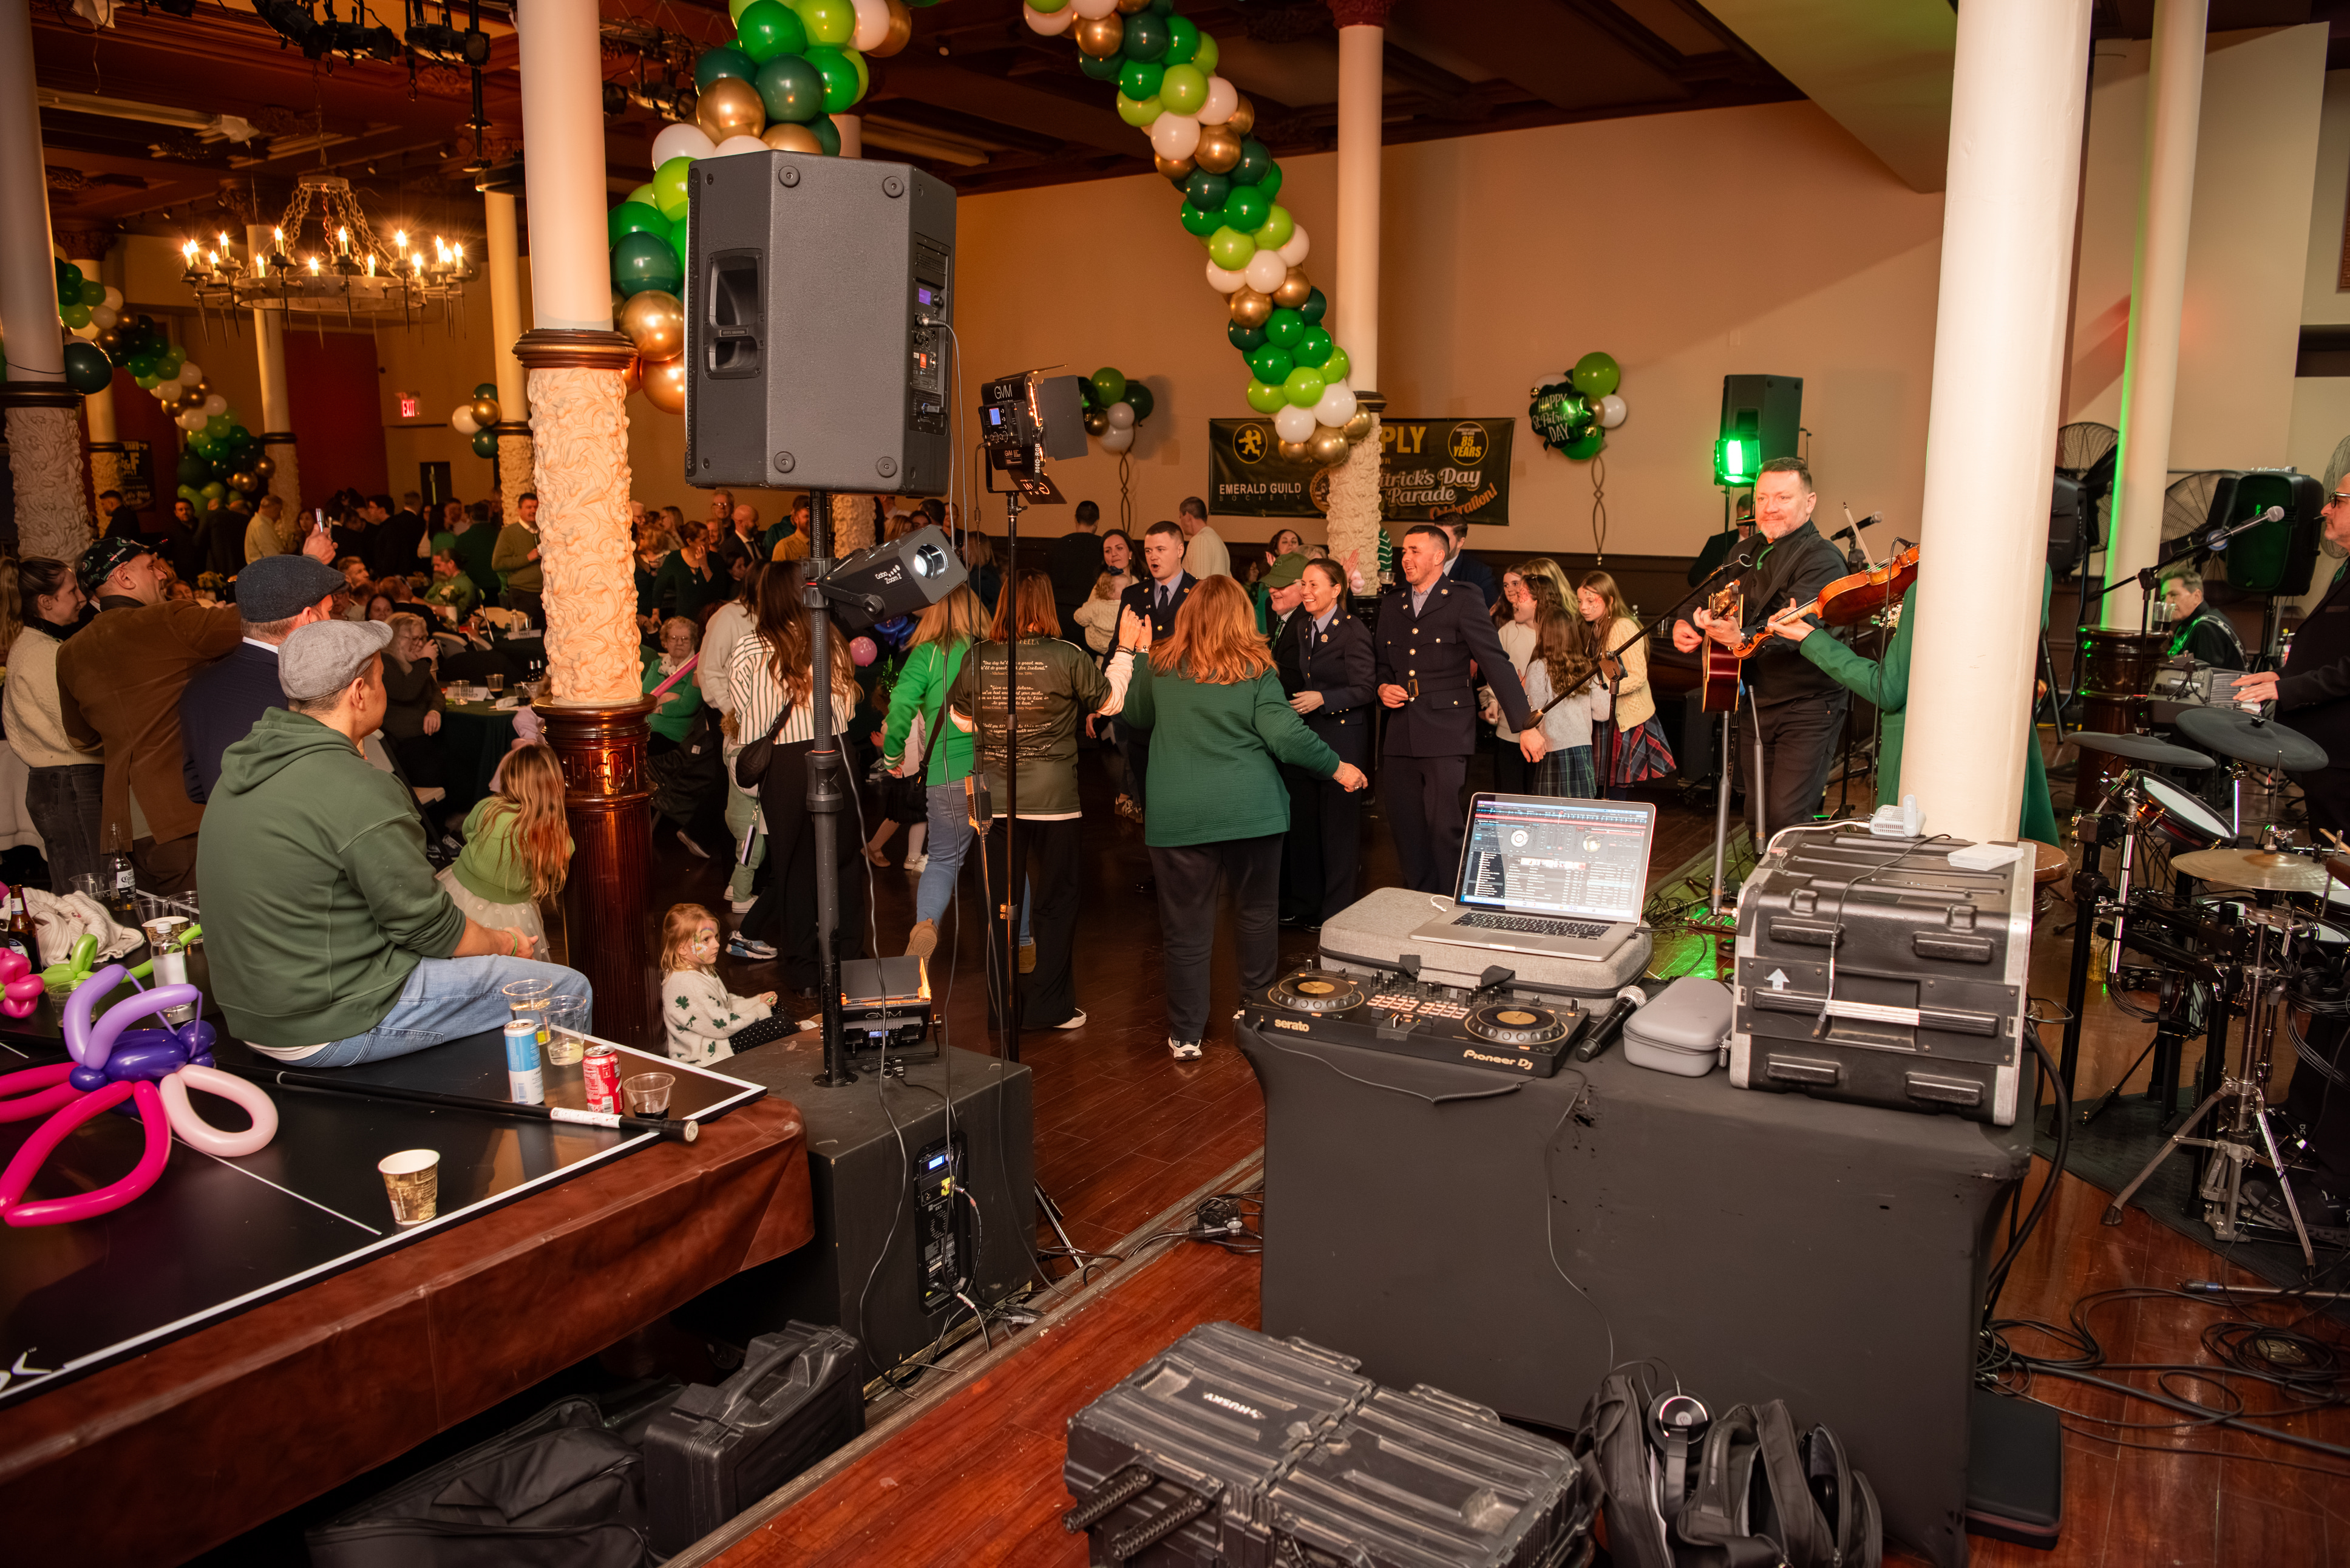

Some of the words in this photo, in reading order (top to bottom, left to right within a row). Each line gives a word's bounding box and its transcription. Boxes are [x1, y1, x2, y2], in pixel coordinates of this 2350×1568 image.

[994, 384, 1013, 399] GVM
[402, 400, 415, 418] EXIT
[1538, 393, 1567, 412] HAPPY
[1549, 423, 1570, 443] DAY
[1461, 435, 1475, 447] 85
[1454, 446, 1482, 458] YEARS
[1438, 467, 1481, 490] Day
[1219, 484, 1266, 495] EMERALD
[1269, 483, 1302, 494] GUILD
[1386, 486, 1456, 505] Parade
[875, 571, 888, 580] Gobo
[884, 575, 899, 585] Zoom
[1274, 1019, 1310, 1032] serato
[1463, 1049, 1516, 1065] Pioneer
[1203, 1392, 1252, 1414] HUSKY
